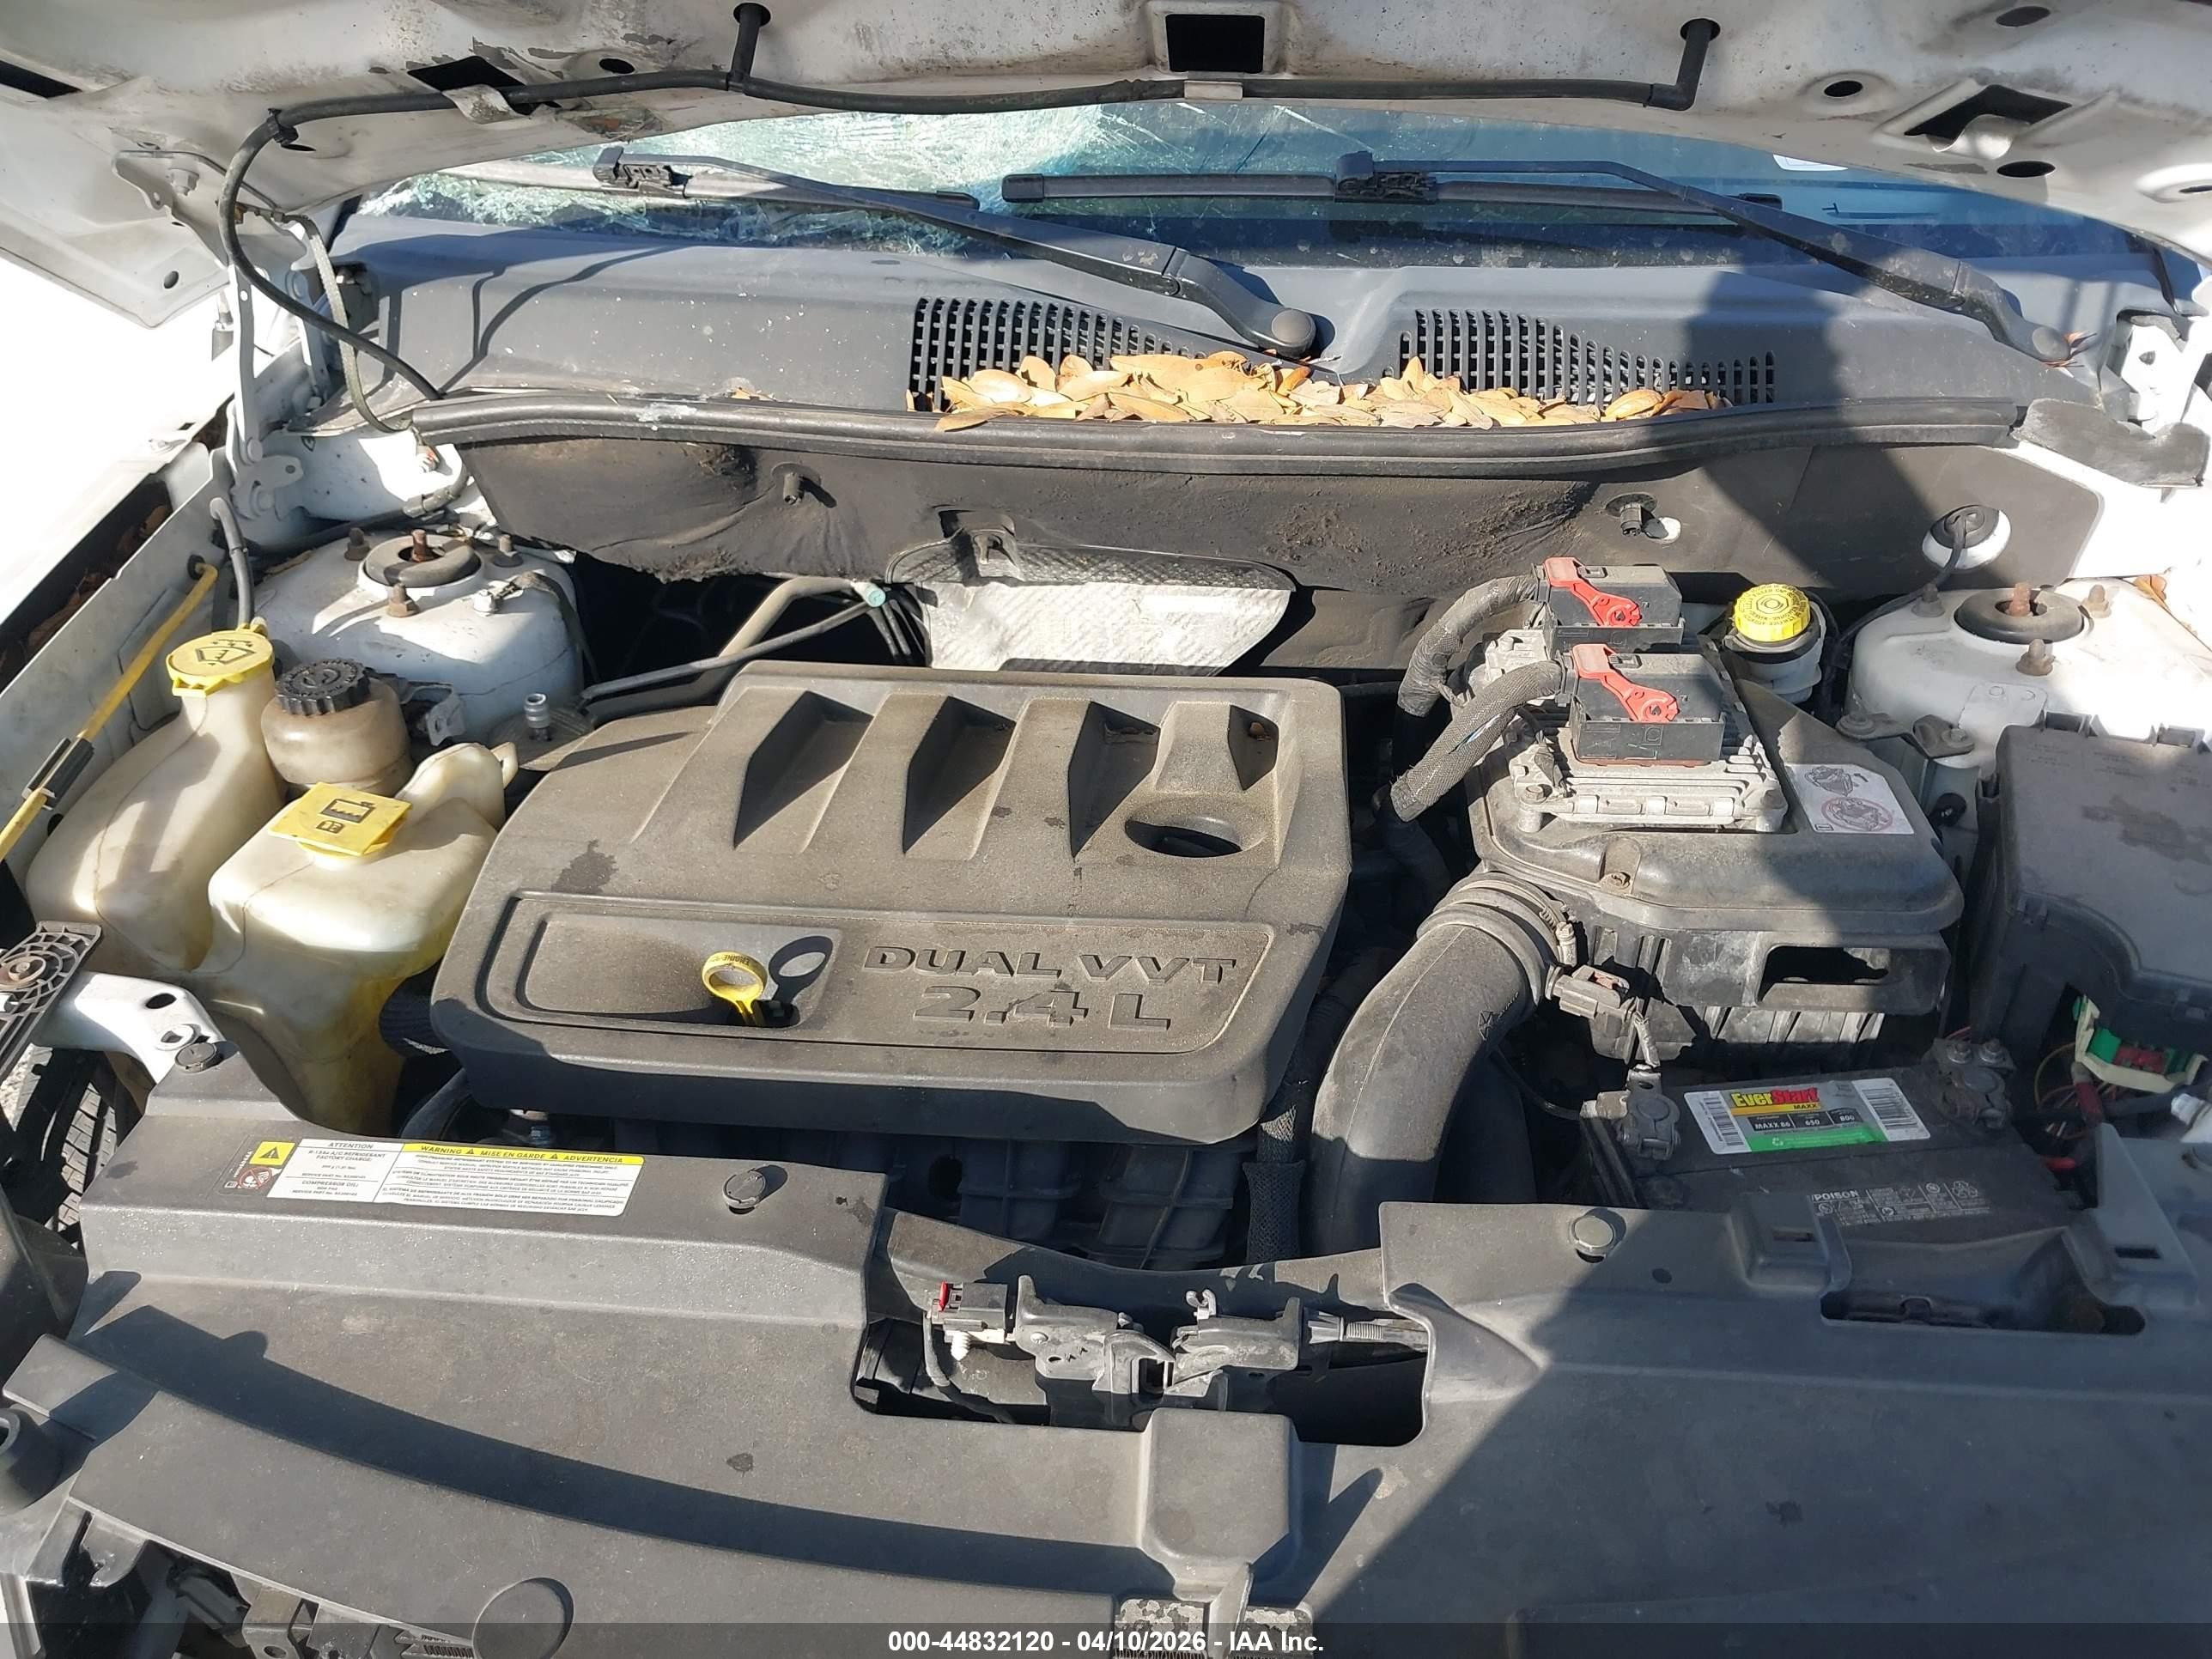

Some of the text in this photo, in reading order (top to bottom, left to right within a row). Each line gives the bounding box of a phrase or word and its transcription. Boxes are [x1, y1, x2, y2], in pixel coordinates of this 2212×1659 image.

[862, 945, 1237, 986] DUAL VVT
[913, 985, 1172, 1031] 2.4 L
[1730, 1085, 1820, 1107] EverStart
[1754, 1121, 1779, 1130] MAXX
[421, 1146, 461, 1154] WARNING
